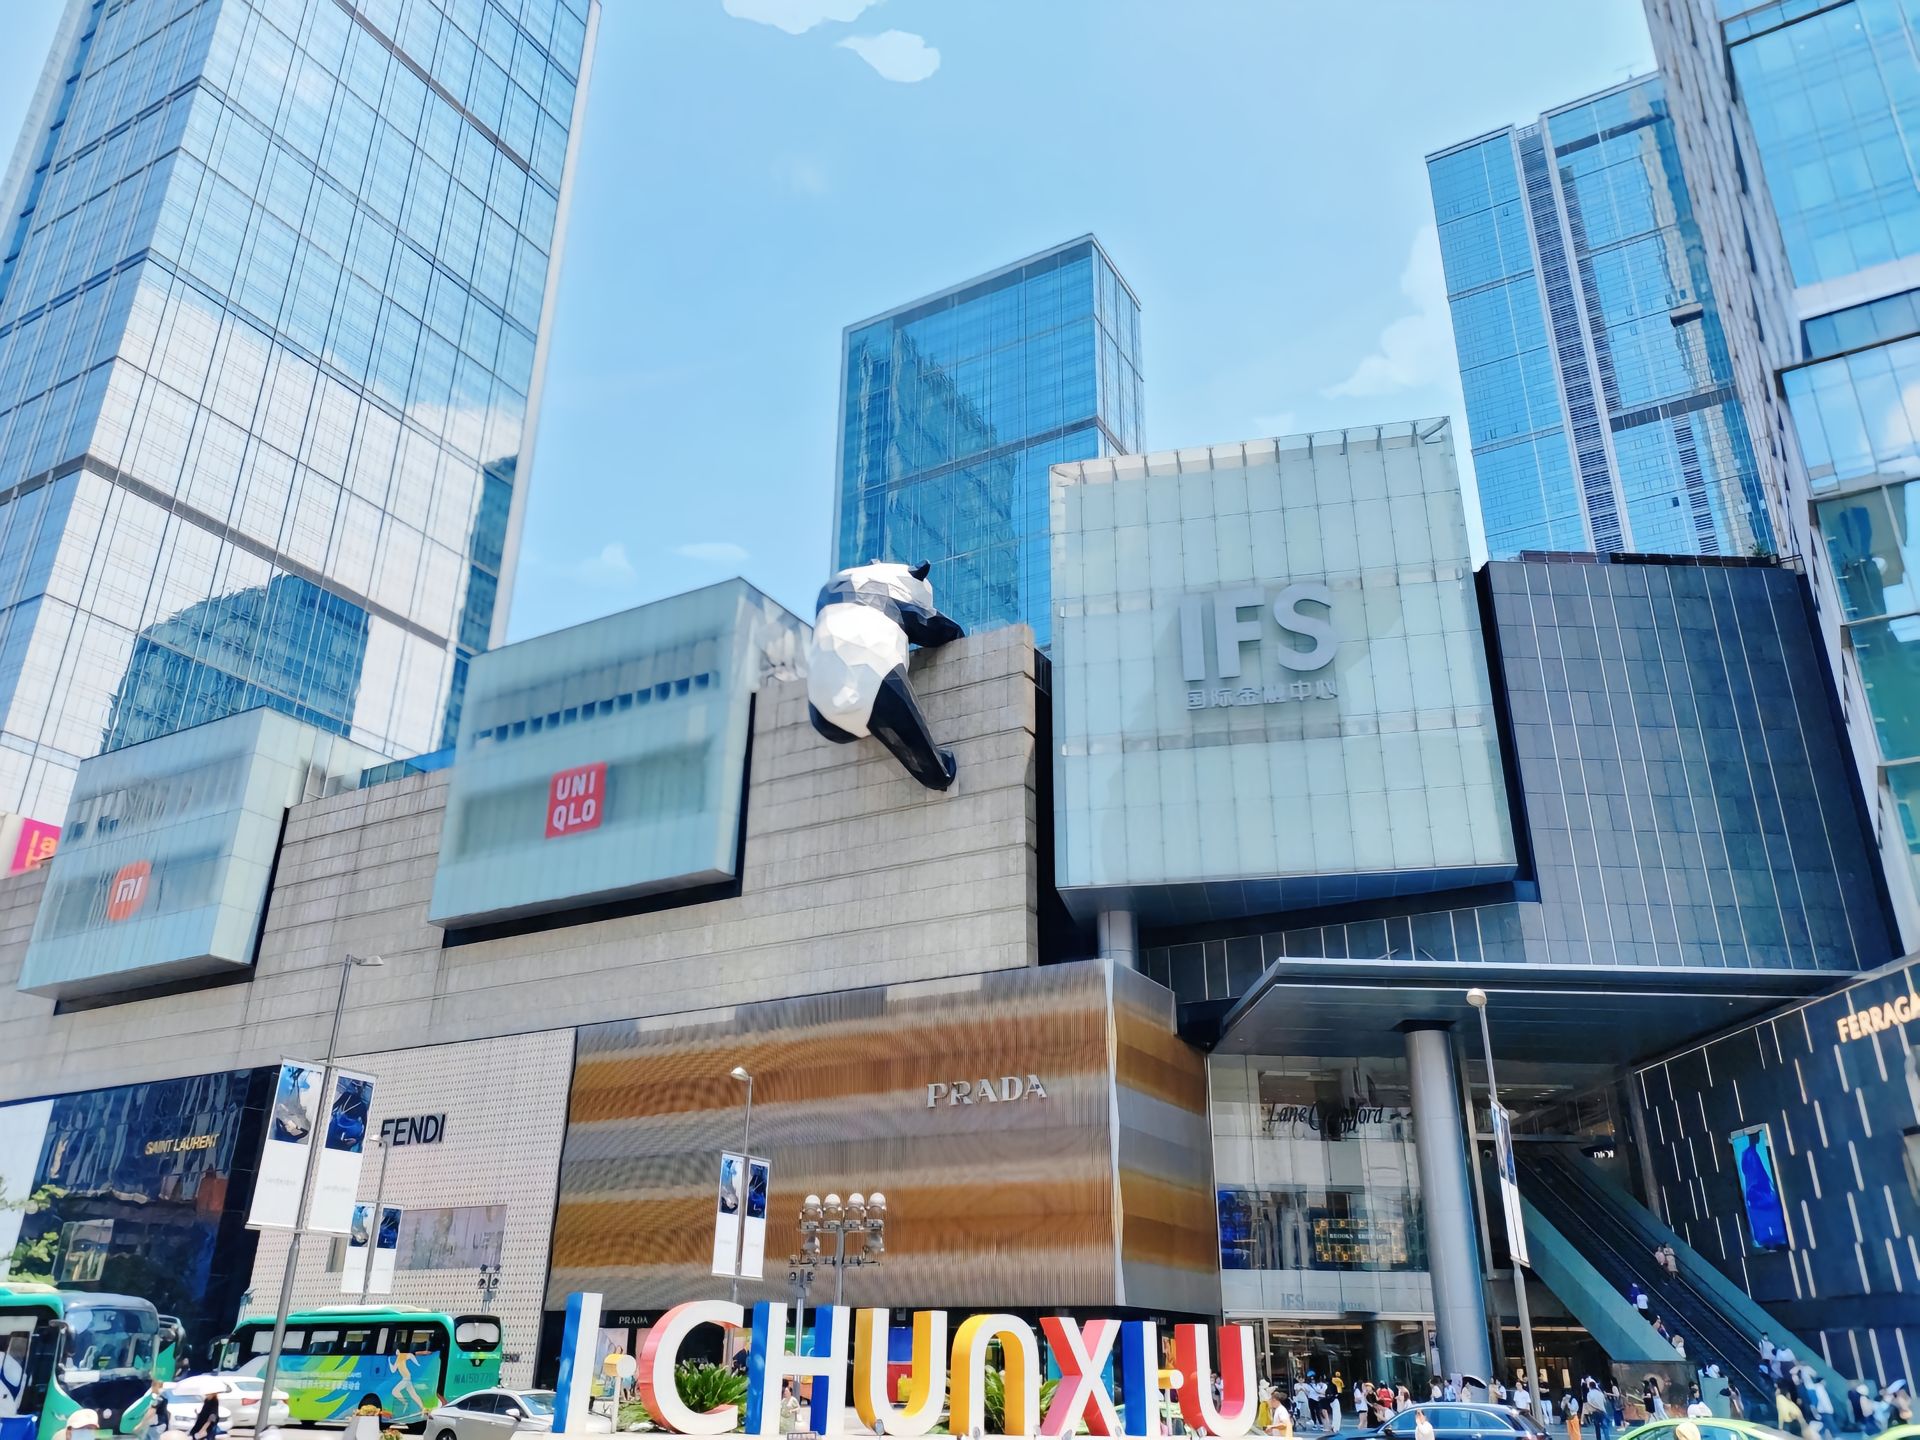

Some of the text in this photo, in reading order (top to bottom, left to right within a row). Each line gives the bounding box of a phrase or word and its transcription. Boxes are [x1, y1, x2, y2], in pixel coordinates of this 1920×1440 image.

[1179, 583, 1337, 682] IFS
[556, 770, 595, 801] UNI
[552, 798, 596, 832] QLO
[927, 1074, 1048, 1108] PRADA
[144, 1134, 220, 1155] SAINT LAURENT
[380, 1114, 446, 1146] FENDI
[618, 1316, 649, 1325] PRADA
